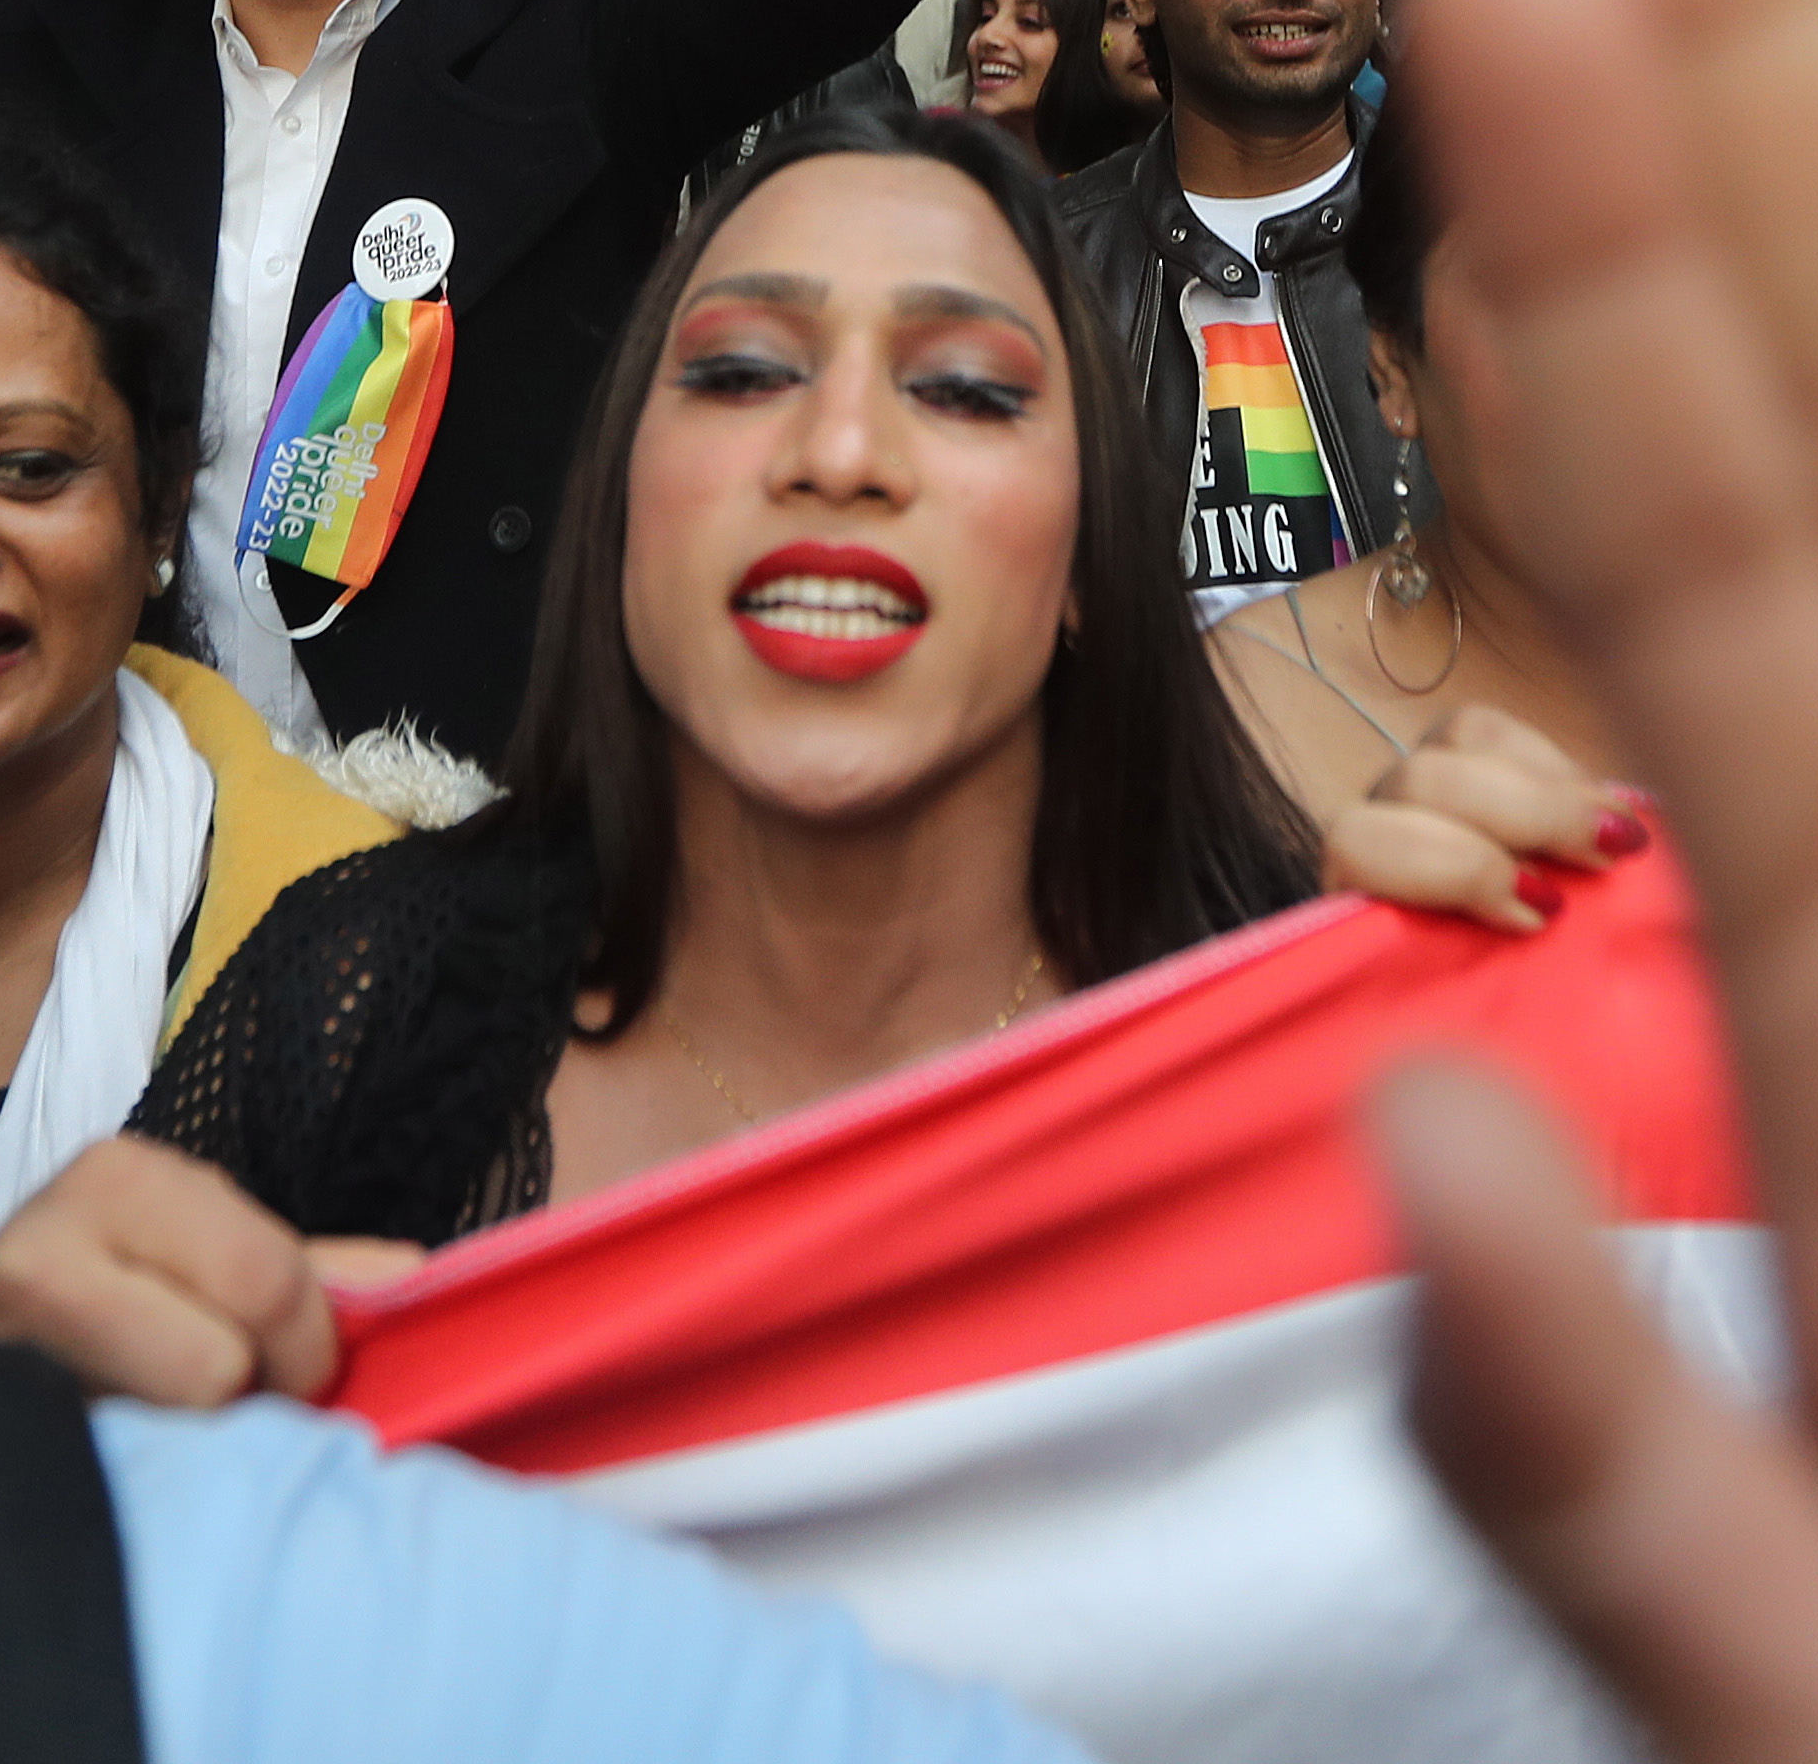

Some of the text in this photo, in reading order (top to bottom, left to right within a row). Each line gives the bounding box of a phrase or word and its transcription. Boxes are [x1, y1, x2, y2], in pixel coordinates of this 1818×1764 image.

[362, 223, 404, 249] Delhi
[368, 231, 426, 269] queer
[383, 233, 437, 278] pride
[248, 442, 299, 551] 2022-23
[278, 436, 329, 539] pride
[311, 424, 358, 530] queer
[343, 422, 389, 499] Delhi
